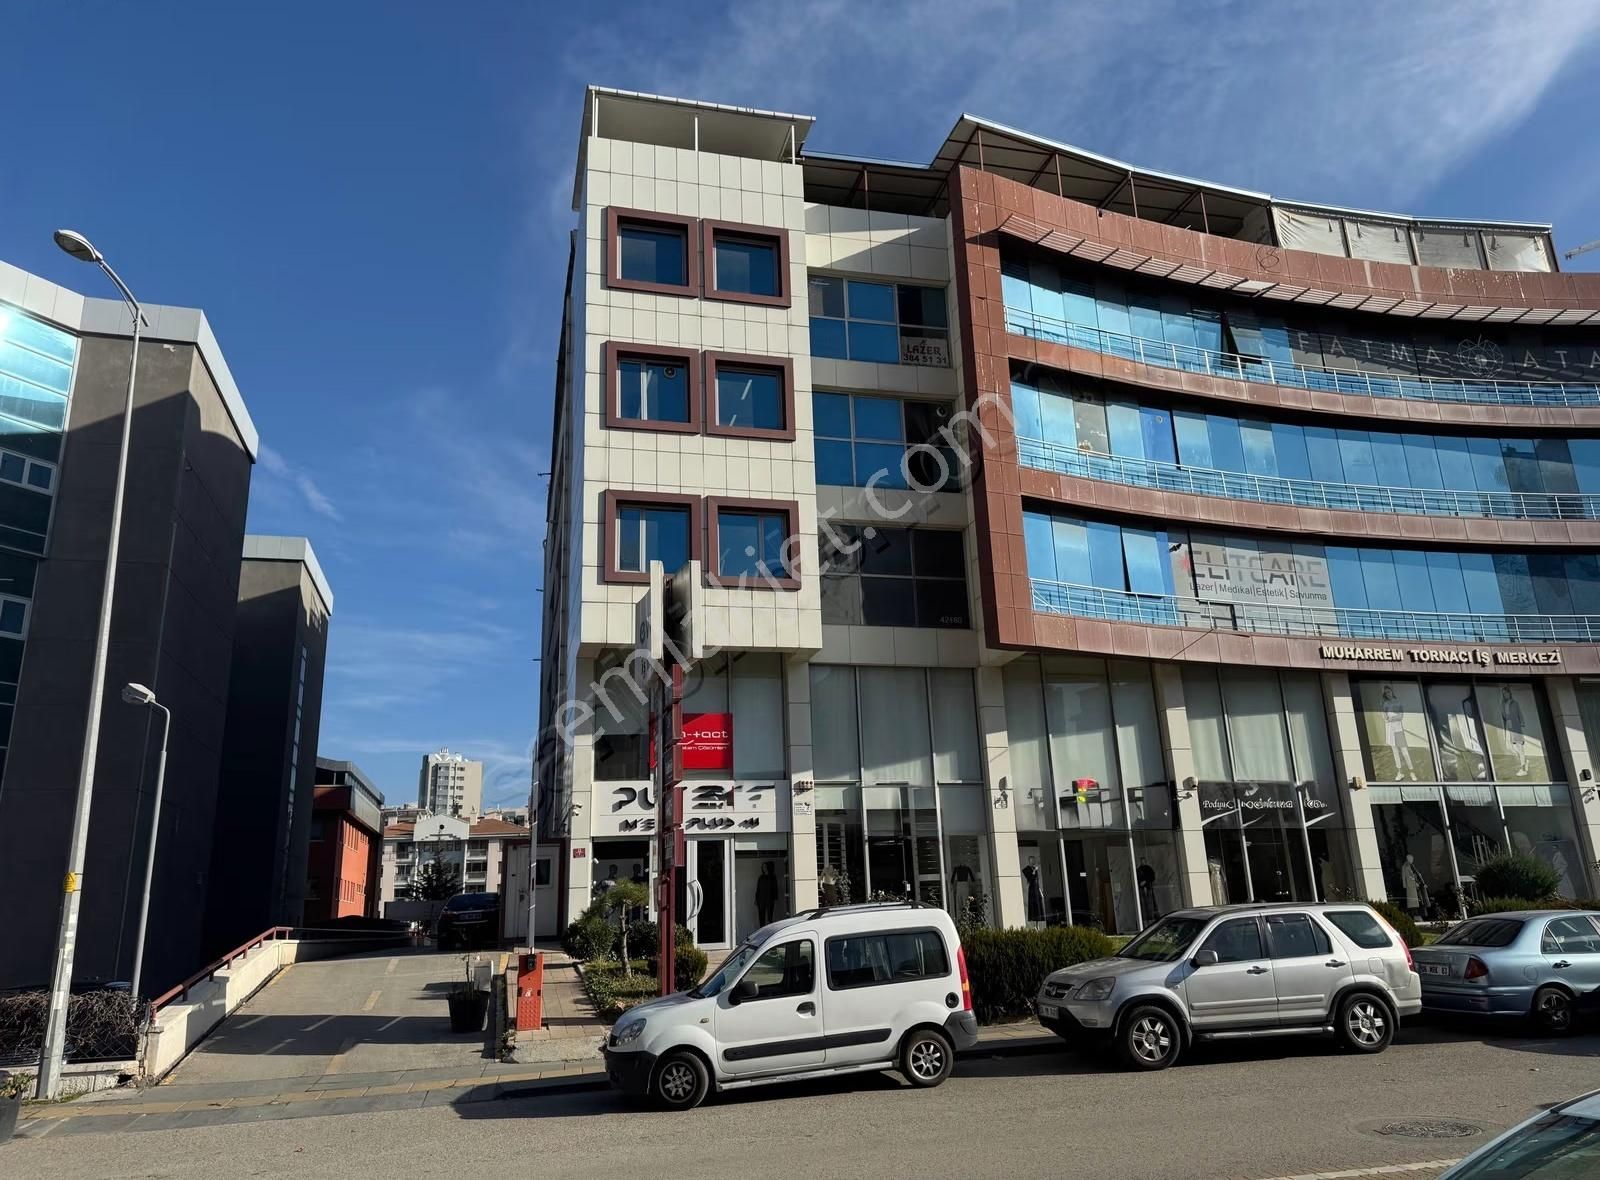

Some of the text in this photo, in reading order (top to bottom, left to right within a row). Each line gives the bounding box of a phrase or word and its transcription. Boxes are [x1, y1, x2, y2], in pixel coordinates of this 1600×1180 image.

[906, 344, 941, 355] LAZER
[1298, 332, 1443, 364] FATMA
[1219, 585, 1252, 595] Medikal
[1256, 589, 1284, 598] Estetik
[1289, 590, 1327, 600] Savunma
[1321, 646, 1562, 667] MUHARREM TORNACI İŞ MERKEZİ
